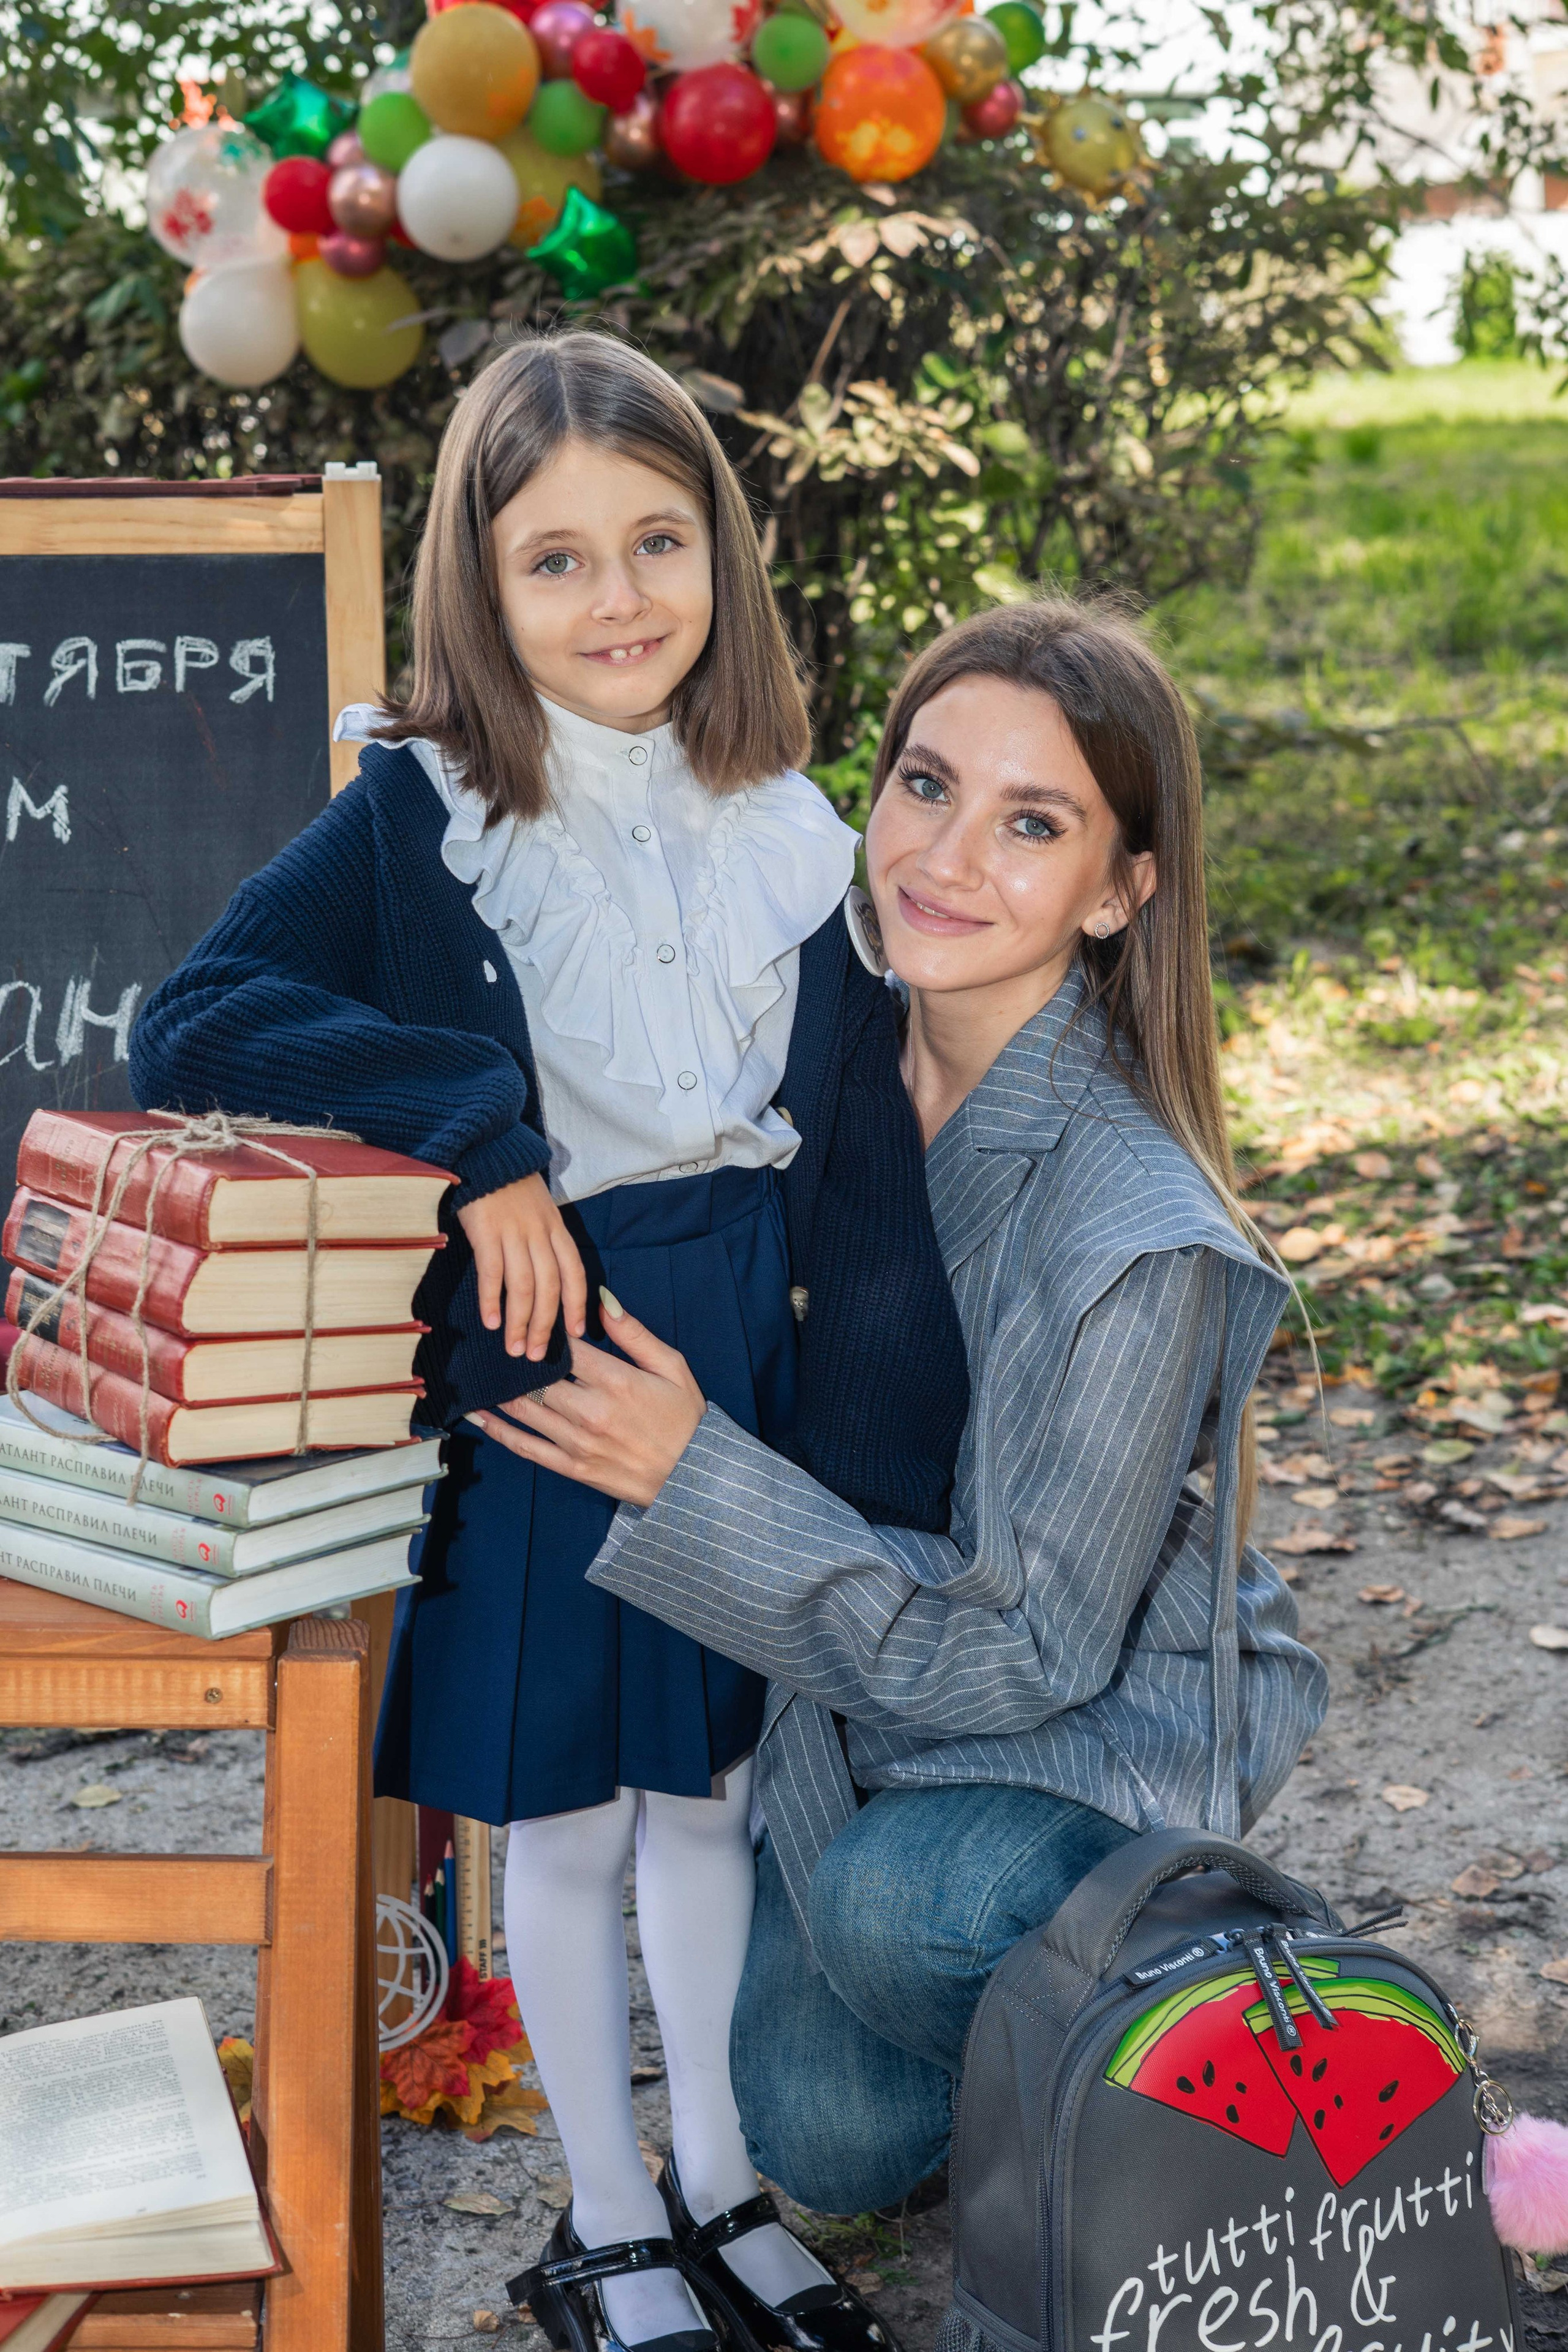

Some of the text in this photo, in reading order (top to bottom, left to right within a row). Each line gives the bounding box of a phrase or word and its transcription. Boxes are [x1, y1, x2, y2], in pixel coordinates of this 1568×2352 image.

[0, 1442, 47, 1464] АТЛАНТ
[51, 1455, 126, 1485] РАСПРАВИЛ
[0, 1495, 157, 1545] АНТ РАСПРАВИЛ ПЛЕЧИ
[17, 1556, 89, 1588] РАСПРАВИЛ
[94, 1578, 137, 1602] ПЛЕЧИ
[1135, 1968, 1163, 1980] Bruno
[1159, 1952, 1195, 1972] Visconti
[1254, 1947, 1273, 1978] Bruno
[1269, 1980, 1292, 2023] Visconti
[1148, 2151, 1474, 2295] tutti frutti
[1090, 2256, 1317, 2352] fresh
[1350, 2225, 1396, 2326] &
